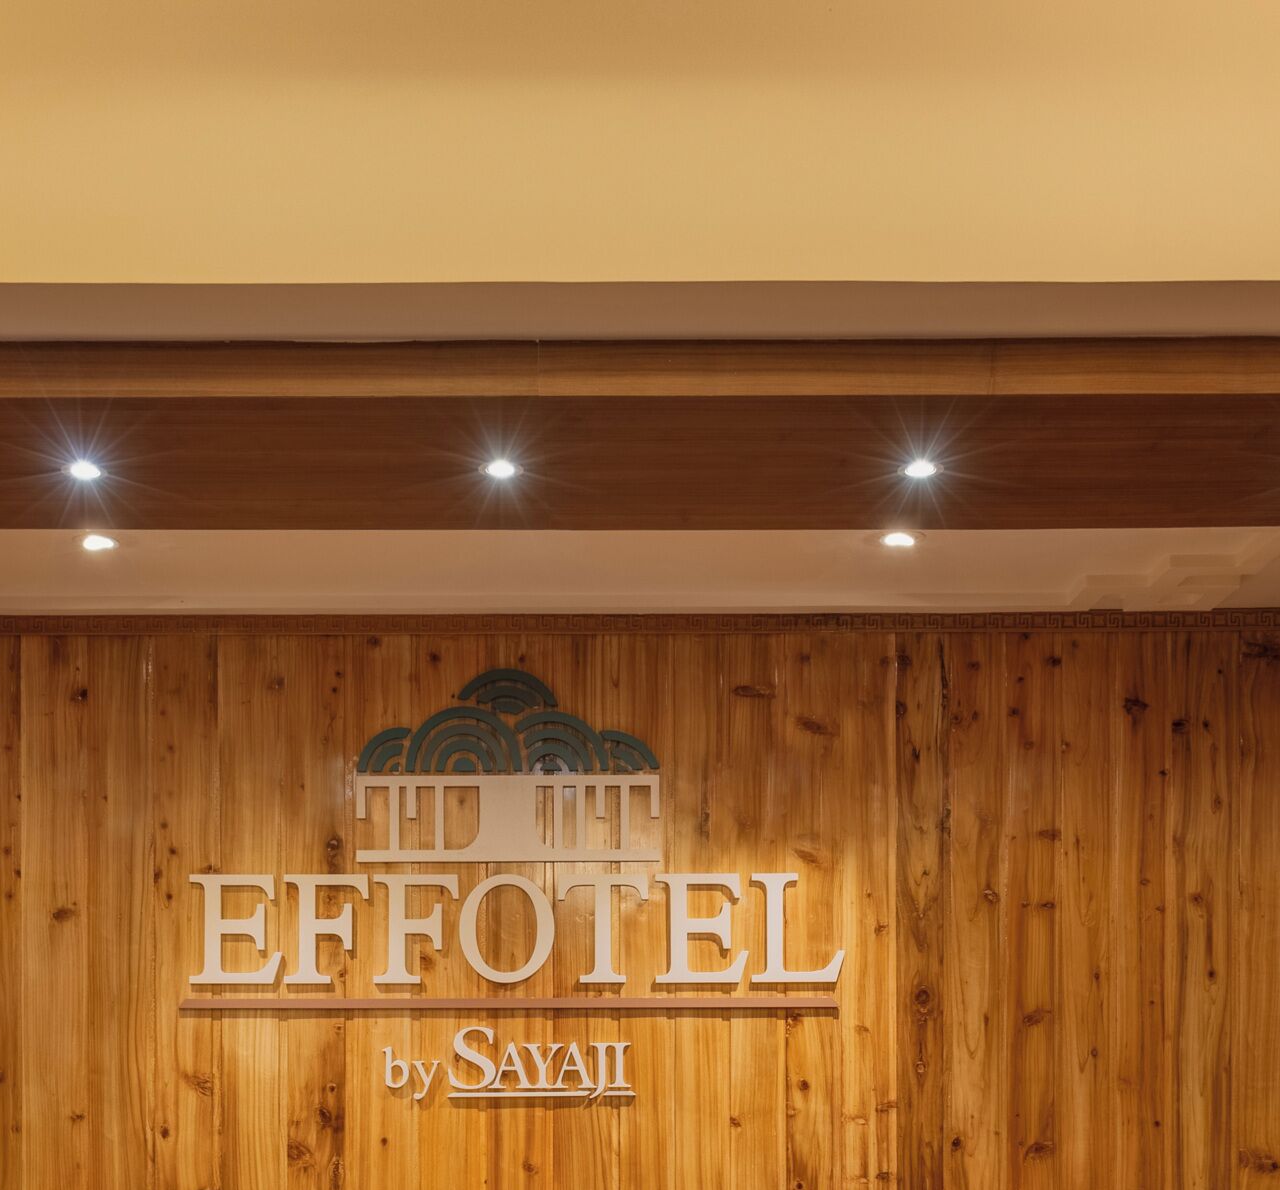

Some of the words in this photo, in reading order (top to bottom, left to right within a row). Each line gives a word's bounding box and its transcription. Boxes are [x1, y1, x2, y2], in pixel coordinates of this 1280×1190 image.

[189, 873, 845, 985] EFFOTEL
[382, 1046, 440, 1100] by
[447, 1026, 632, 1099] SAYAJI
